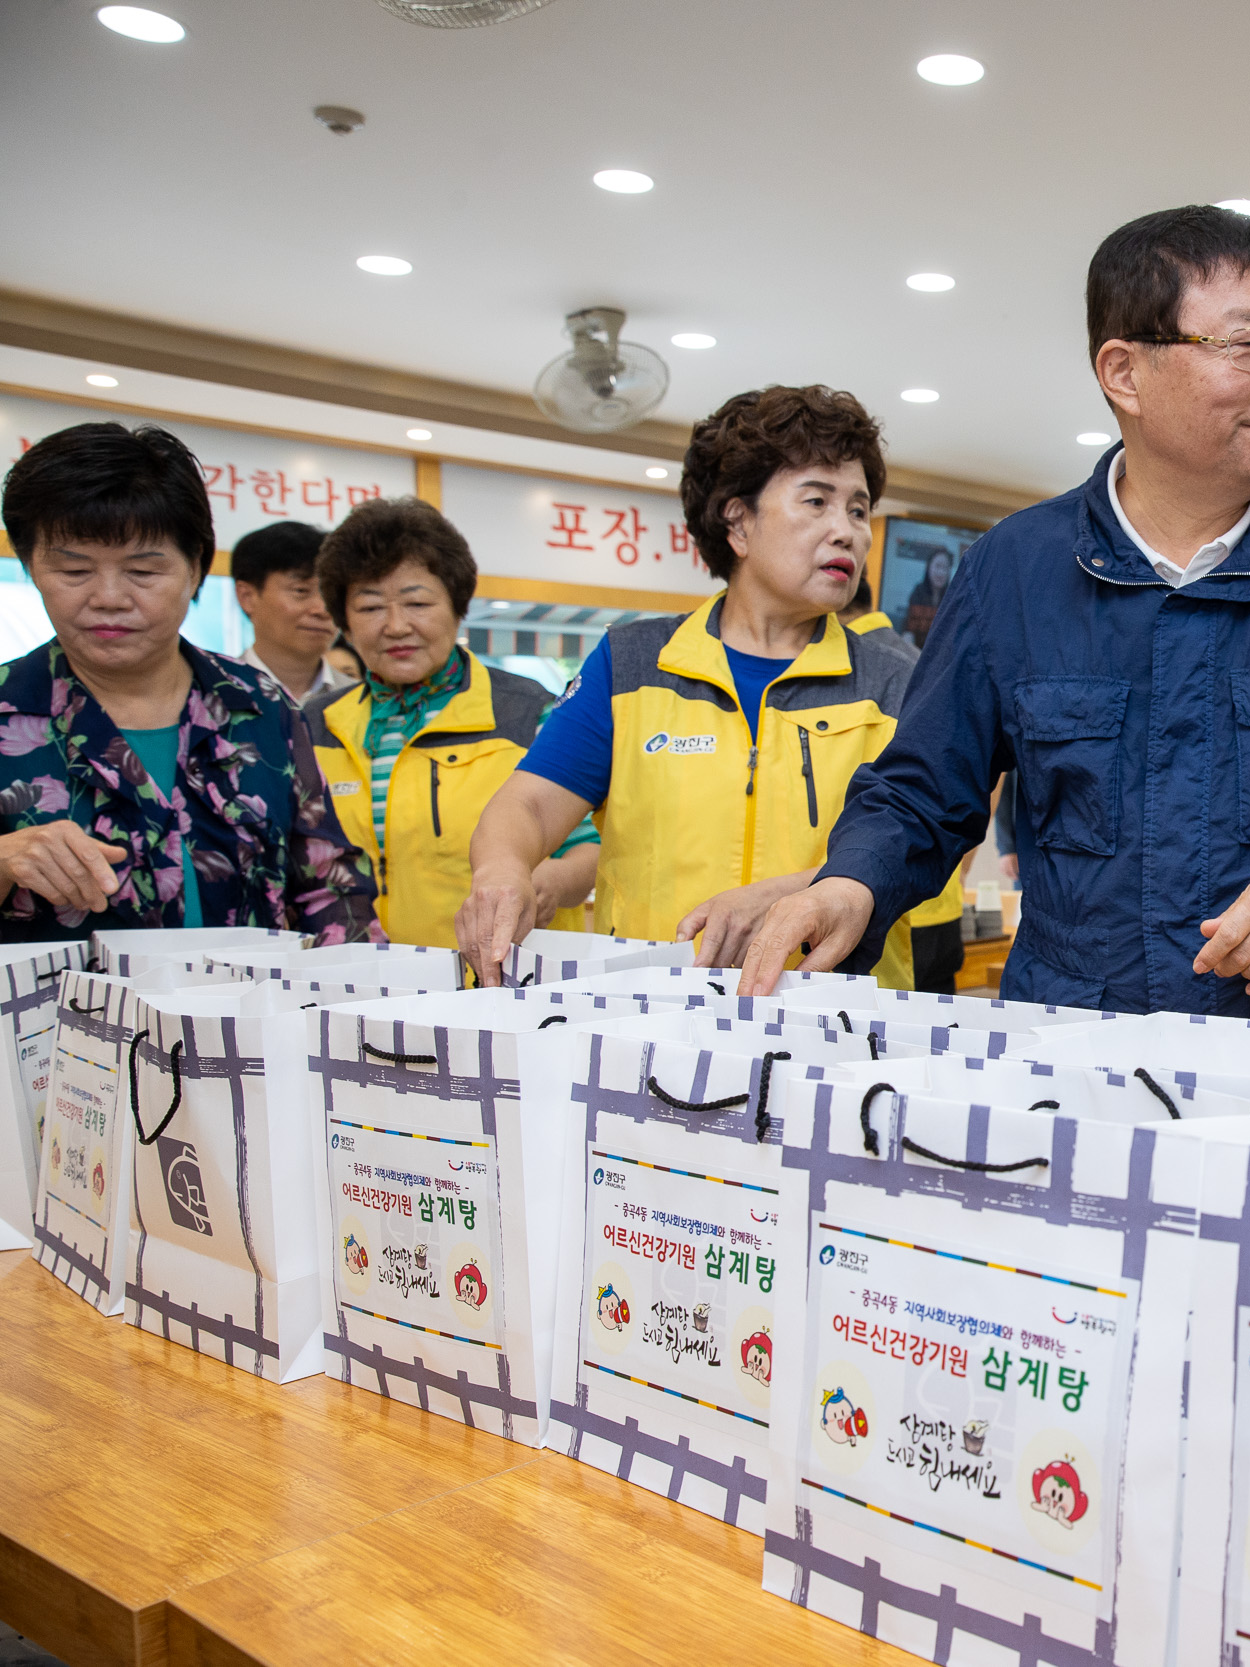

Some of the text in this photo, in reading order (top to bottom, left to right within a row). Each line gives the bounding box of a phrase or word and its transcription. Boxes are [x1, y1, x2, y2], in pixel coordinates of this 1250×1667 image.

[674, 736, 714, 749] 광진구
[84, 1105, 106, 1137] 삼계탕
[354, 1162, 372, 1179] 중곡4동
[374, 1167, 432, 1188] 지역사회보장협의체와
[434, 1178, 461, 1195] 함께하는
[606, 1170, 626, 1184] 광진구
[342, 1182, 478, 1230] 어르신건강기원 삼계탕
[623, 1202, 648, 1222] 중곡4동
[651, 1209, 726, 1238] 지역사회보장협의체와
[729, 1228, 762, 1251] 함께하는
[382, 1245, 412, 1270] 삼계탕
[603, 1224, 776, 1294] 어르신건강기원 삼계탕
[839, 1248, 869, 1266] 광진구
[651, 1300, 689, 1331] 삼계탕
[861, 1288, 898, 1314] 중곡4동
[903, 1299, 1014, 1340] 지역사회보장협의체와
[1020, 1328, 1068, 1359] 함께하는
[832, 1314, 1090, 1413] 어르신건강기원 삼계탕
[899, 1413, 956, 1451] 삼계탕
